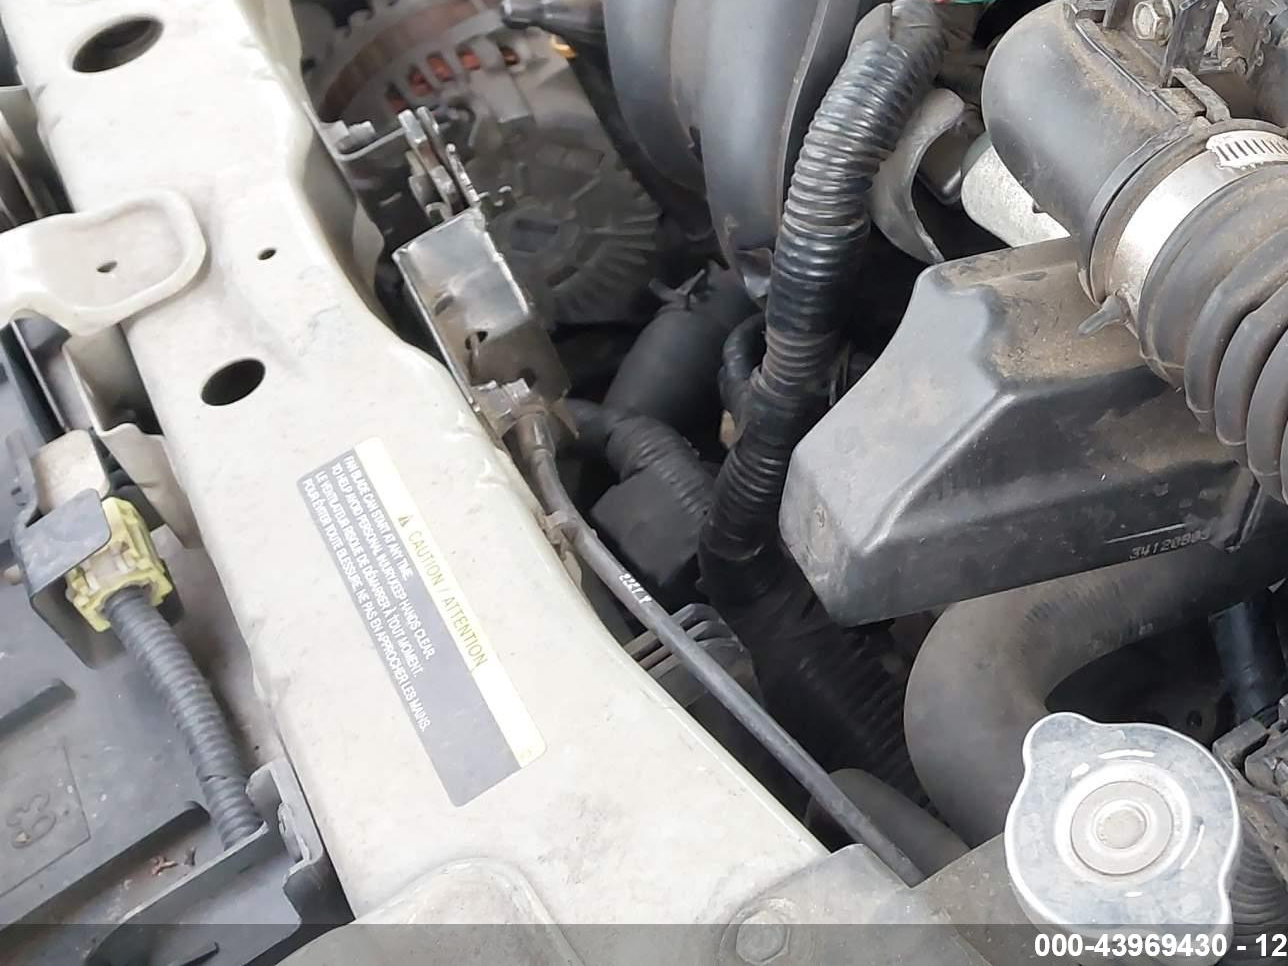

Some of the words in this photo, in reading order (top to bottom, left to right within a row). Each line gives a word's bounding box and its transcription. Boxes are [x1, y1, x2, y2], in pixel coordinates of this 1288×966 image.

[314, 470, 328, 483] LE
[329, 462, 343, 476] TO
[342, 454, 358, 472] FAN
[300, 477, 320, 502] POUR
[334, 472, 353, 495] HELP
[349, 469, 371, 496] BLADE
[318, 479, 351, 529] VENTILATEUR
[343, 490, 364, 517] AVOID
[361, 492, 379, 512] CAN
[354, 513, 384, 556] PERSONAL
[370, 508, 391, 535] START
[322, 522, 345, 550] TOUTE
[340, 525, 365, 557] RISQUE
[381, 531, 395, 544] AT
[355, 553, 370, 568] DE
[386, 541, 404, 561] ANY
[355, 588, 370, 604] NE
[360, 563, 395, 611] DÉMARRER
[406, 528, 446, 586] CAUTION
[440, 593, 489, 668] ATTENTION
[359, 600, 378, 620] PAS
[382, 605, 398, 618] À
[397, 598, 422, 631] HANDS
[368, 617, 384, 633] EN
[384, 613, 407, 640] TOUT
[395, 635, 425, 678] MOMENT.
[412, 626, 437, 660] CLEAR.
[372, 629, 410, 685] APPROCHER
[399, 680, 418, 701] LES
[407, 697, 433, 732] MAINS.
